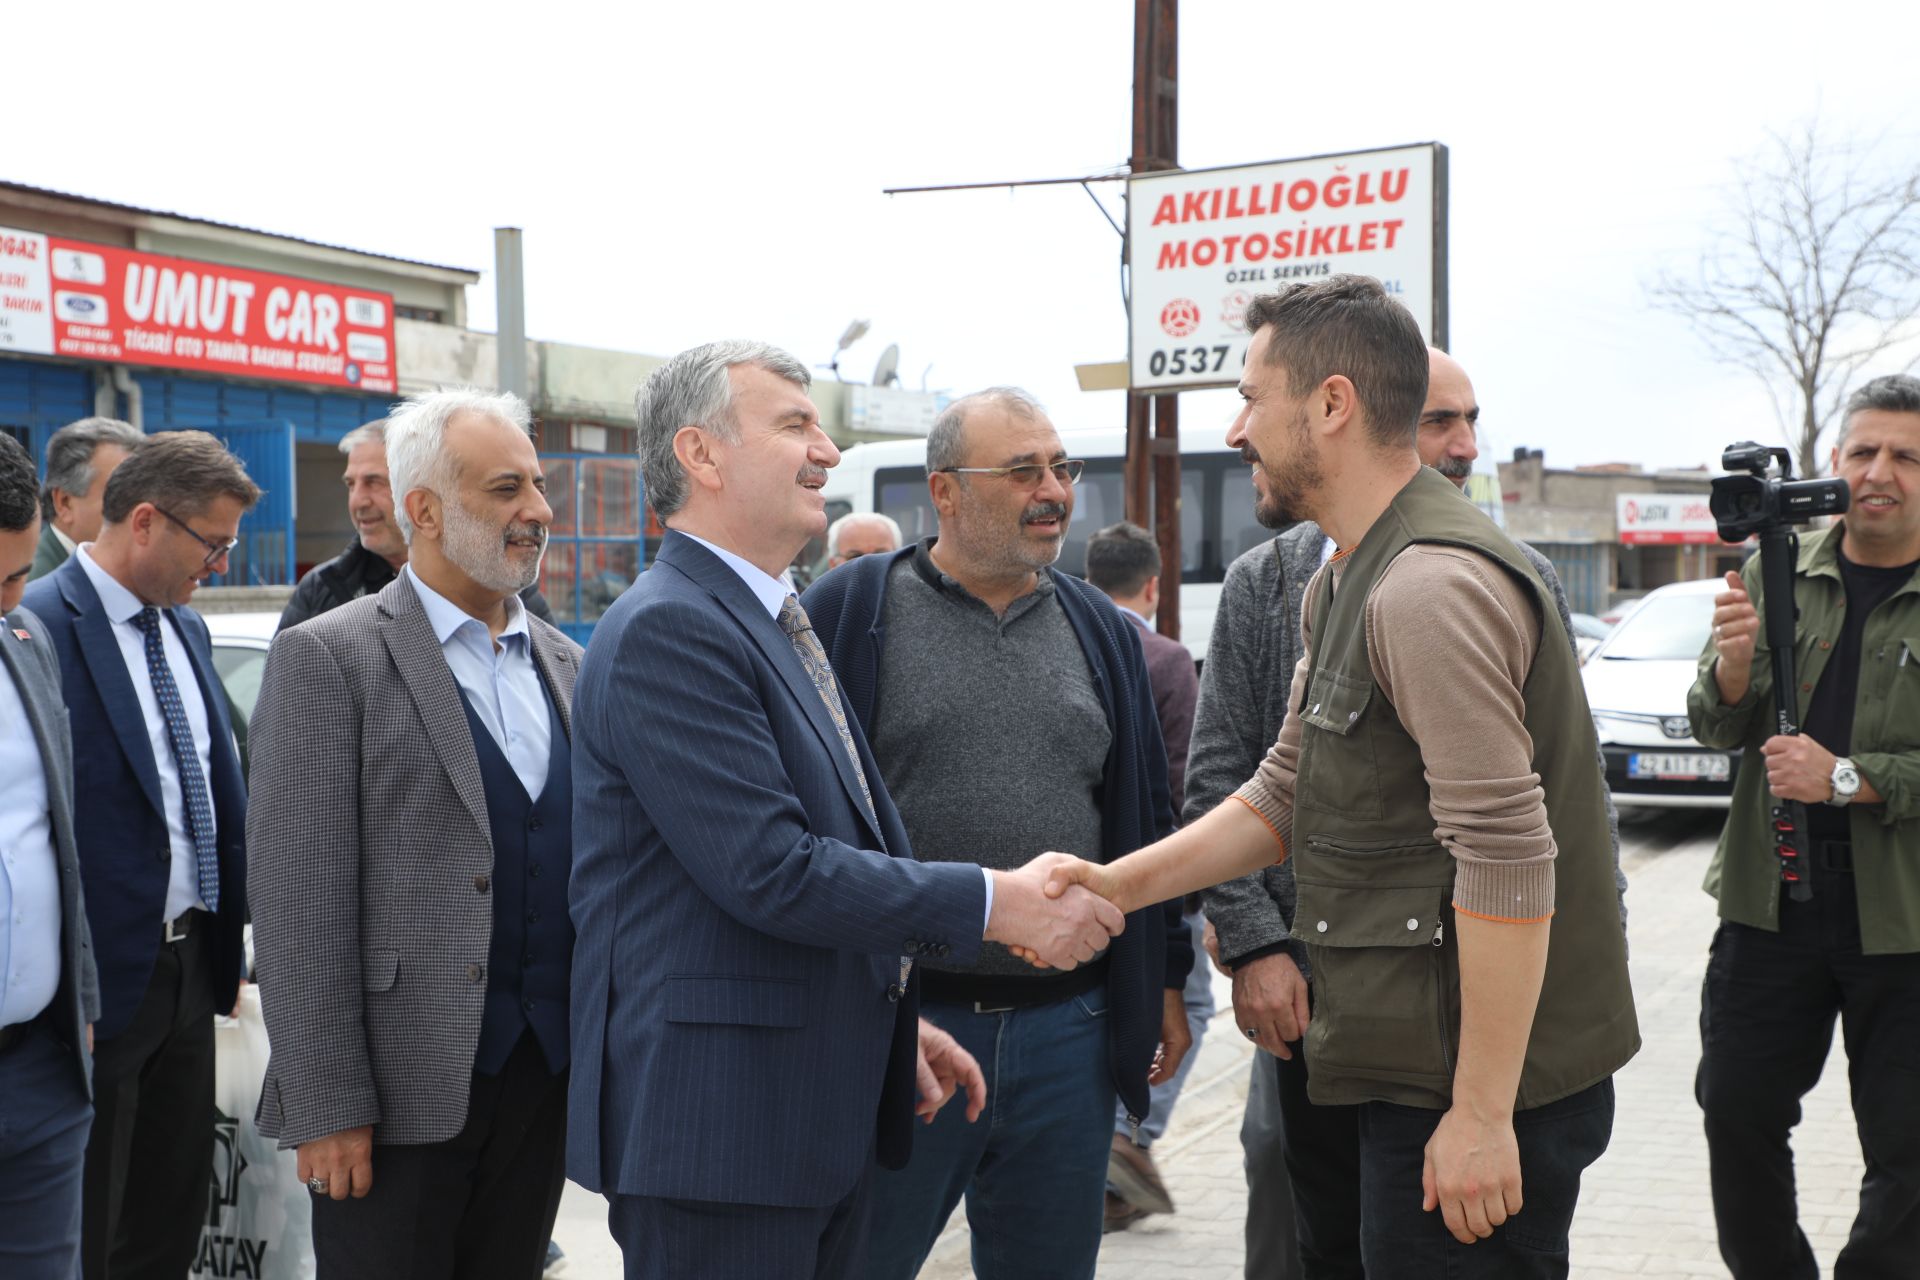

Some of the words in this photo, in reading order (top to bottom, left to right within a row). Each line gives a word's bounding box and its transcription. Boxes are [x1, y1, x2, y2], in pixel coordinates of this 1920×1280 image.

[1151, 165, 1409, 226] AKILLIOĞLU
[1157, 220, 1404, 270] MOTOSİKLET
[1226, 267, 1266, 283] ÖZEL
[1273, 261, 1330, 280] SERVİS
[124, 262, 255, 336] UMUT
[265, 286, 339, 351] CAR
[124, 326, 173, 355] TİCARİ
[175, 336, 203, 358] OTO
[205, 338, 249, 363] TAMİR
[251, 345, 295, 369] BAKIM
[296, 350, 344, 375] SERVİSİ
[1149, 345, 1230, 377] 0537
[191, 1234, 268, 1280] ATAY
